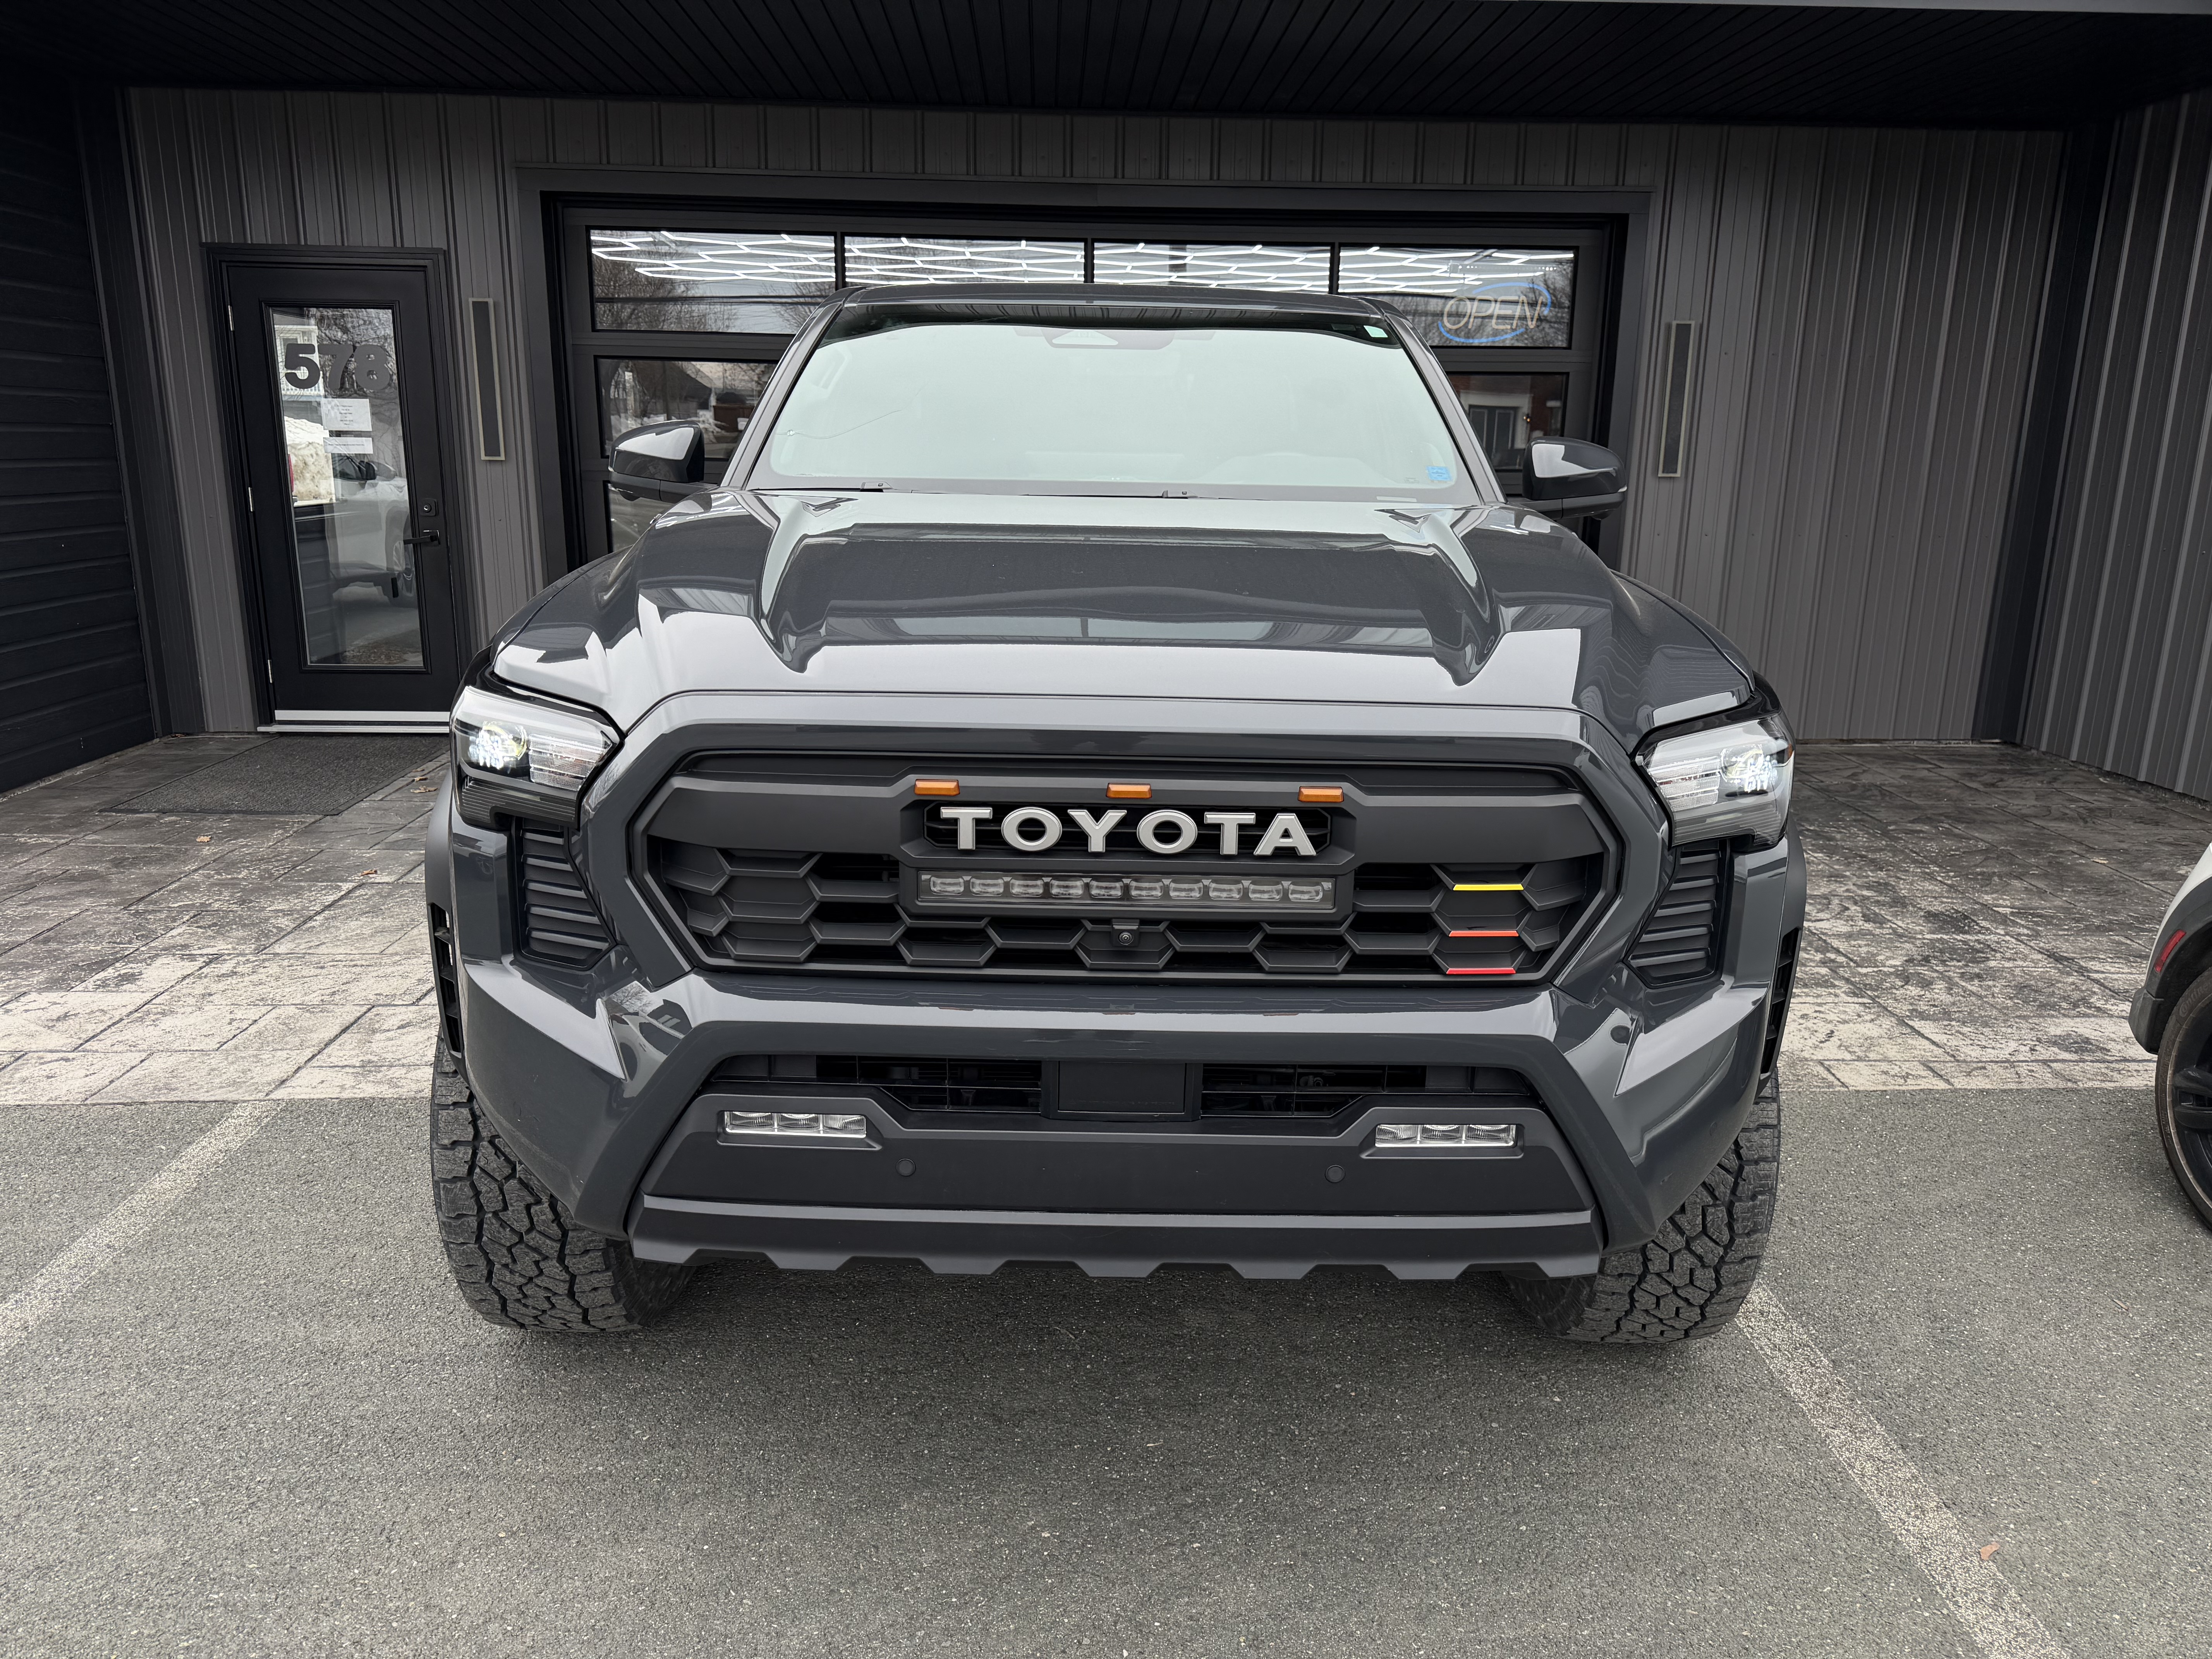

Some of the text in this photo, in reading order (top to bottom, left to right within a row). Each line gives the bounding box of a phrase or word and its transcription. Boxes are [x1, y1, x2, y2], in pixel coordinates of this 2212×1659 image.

[1443, 295, 1543, 329] OPEN
[285, 343, 390, 390] 578
[940, 807, 1317, 856] TOYOTA
